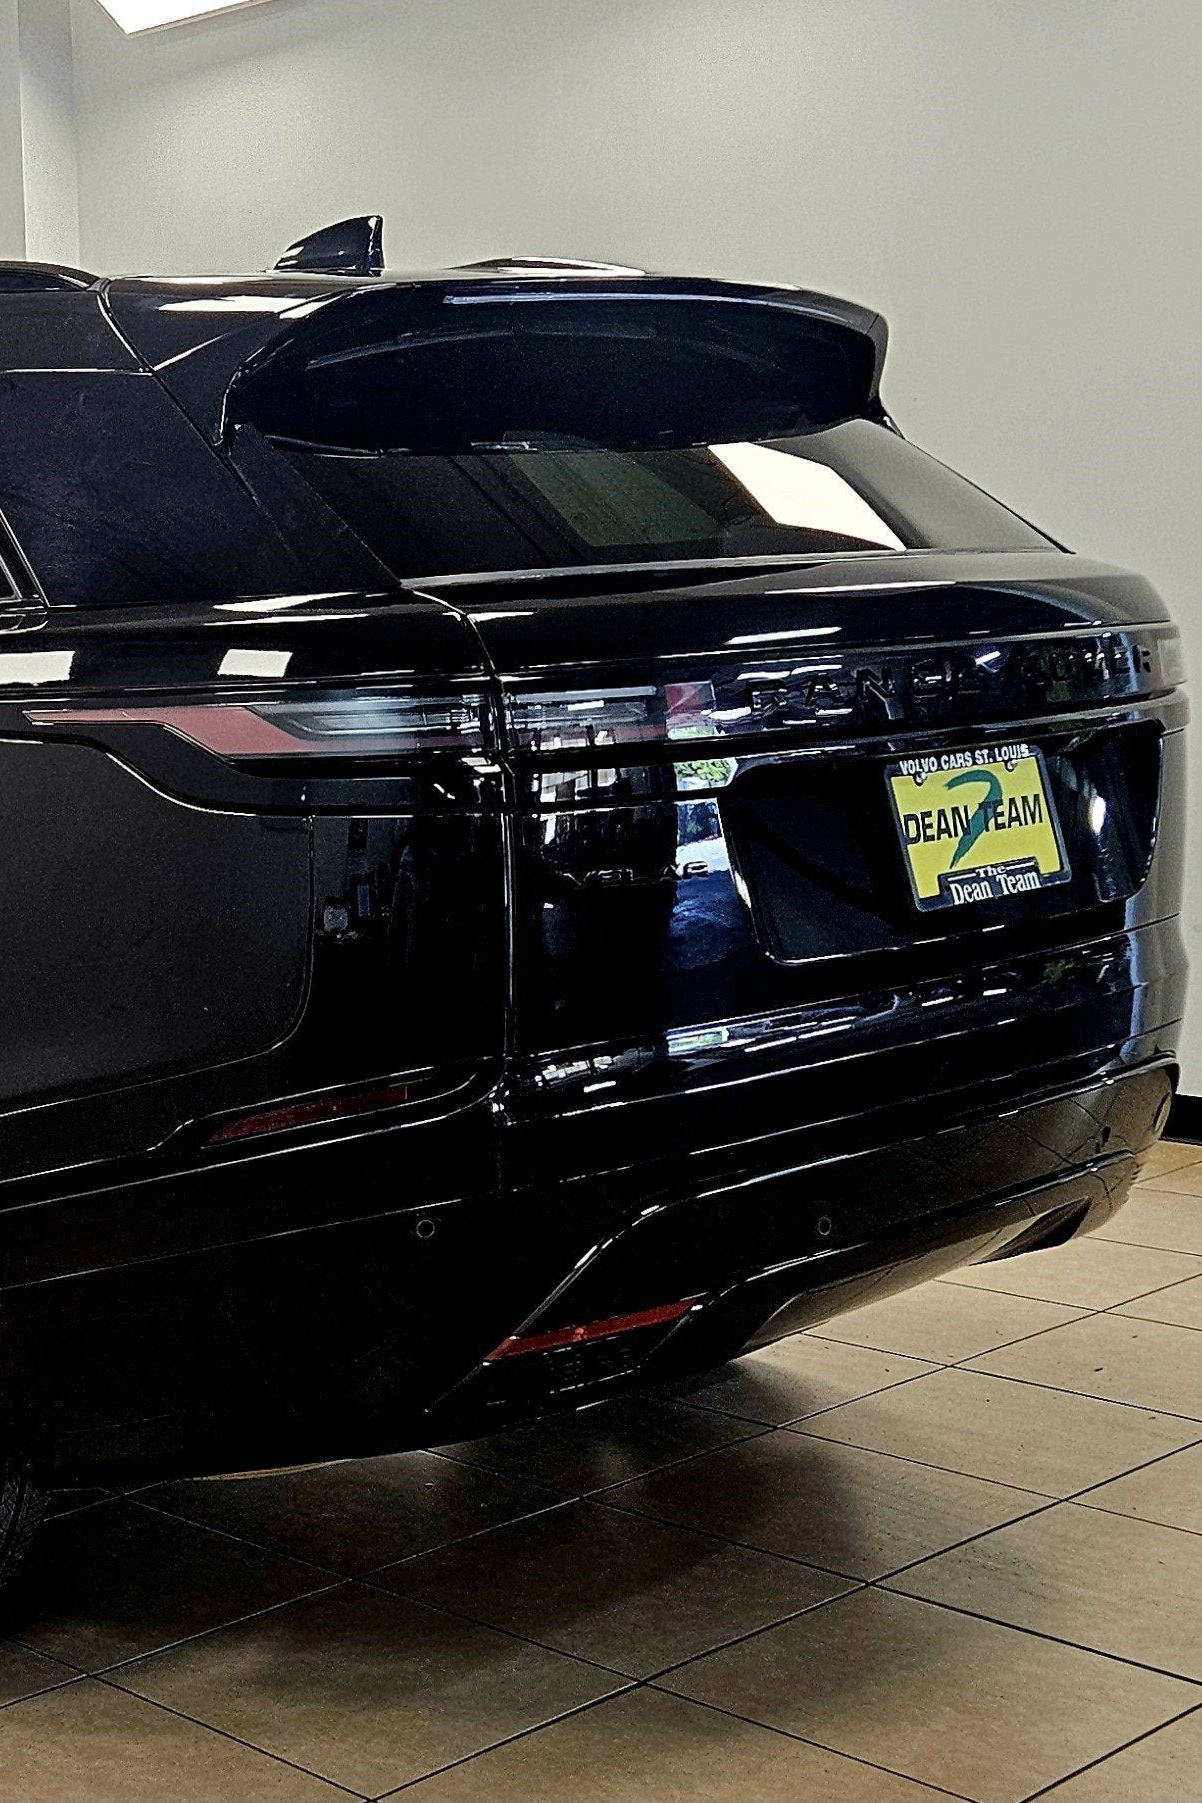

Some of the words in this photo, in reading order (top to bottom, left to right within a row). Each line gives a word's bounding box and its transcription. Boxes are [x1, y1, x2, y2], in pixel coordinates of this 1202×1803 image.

[899, 756, 936, 776] VOLVO
[941, 751, 972, 770] CARS
[974, 749, 993, 766] ST.
[995, 744, 1030, 762] LOUIS
[903, 804, 971, 845] DEAN
[978, 794, 1043, 833] TEAM
[975, 864, 1007, 878] The
[949, 880, 993, 905] Dean
[996, 871, 1041, 896] Team
